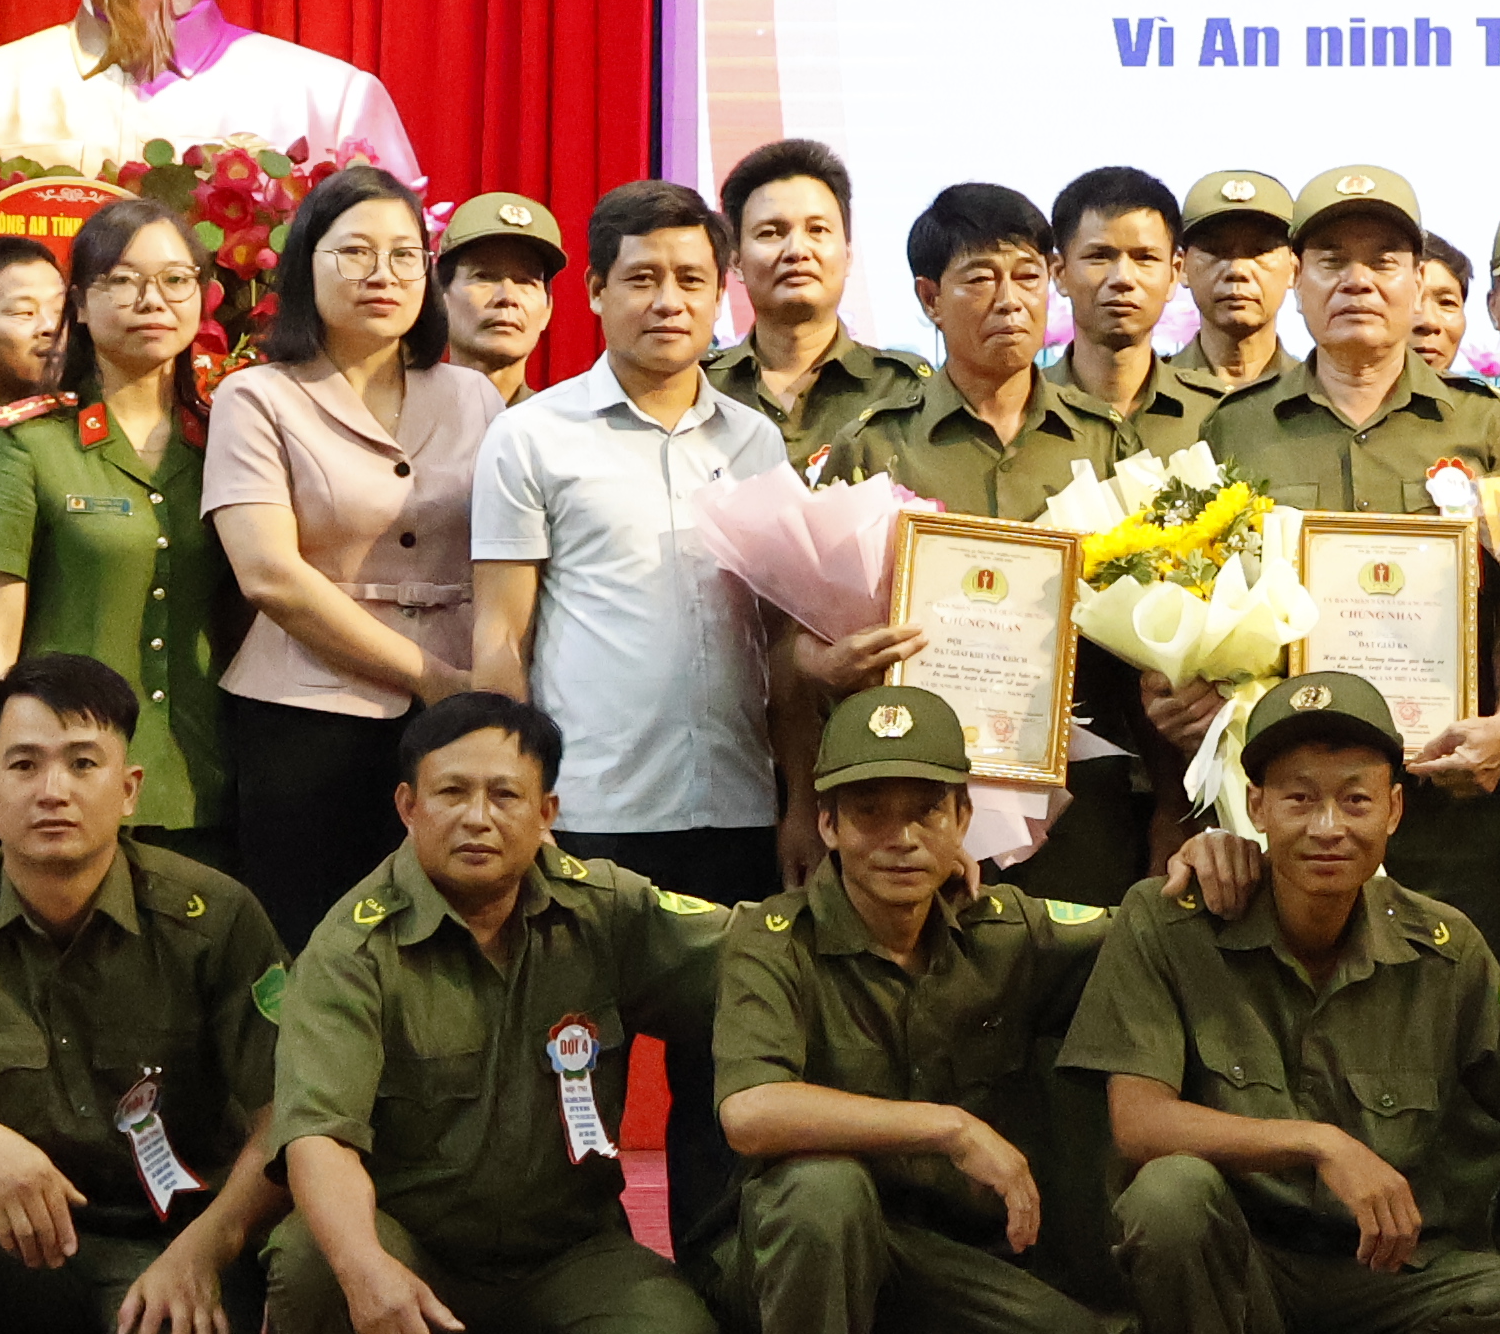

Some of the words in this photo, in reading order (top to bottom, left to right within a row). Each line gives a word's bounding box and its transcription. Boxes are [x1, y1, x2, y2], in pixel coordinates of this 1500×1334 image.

[1112, 15, 1176, 67] Vì
[1198, 17, 1280, 67] An
[1306, 17, 1452, 67] ninh
[28, 215, 48, 236] AN
[560, 1036, 578, 1057] ĐỘI
[581, 1038, 589, 1055] 4
